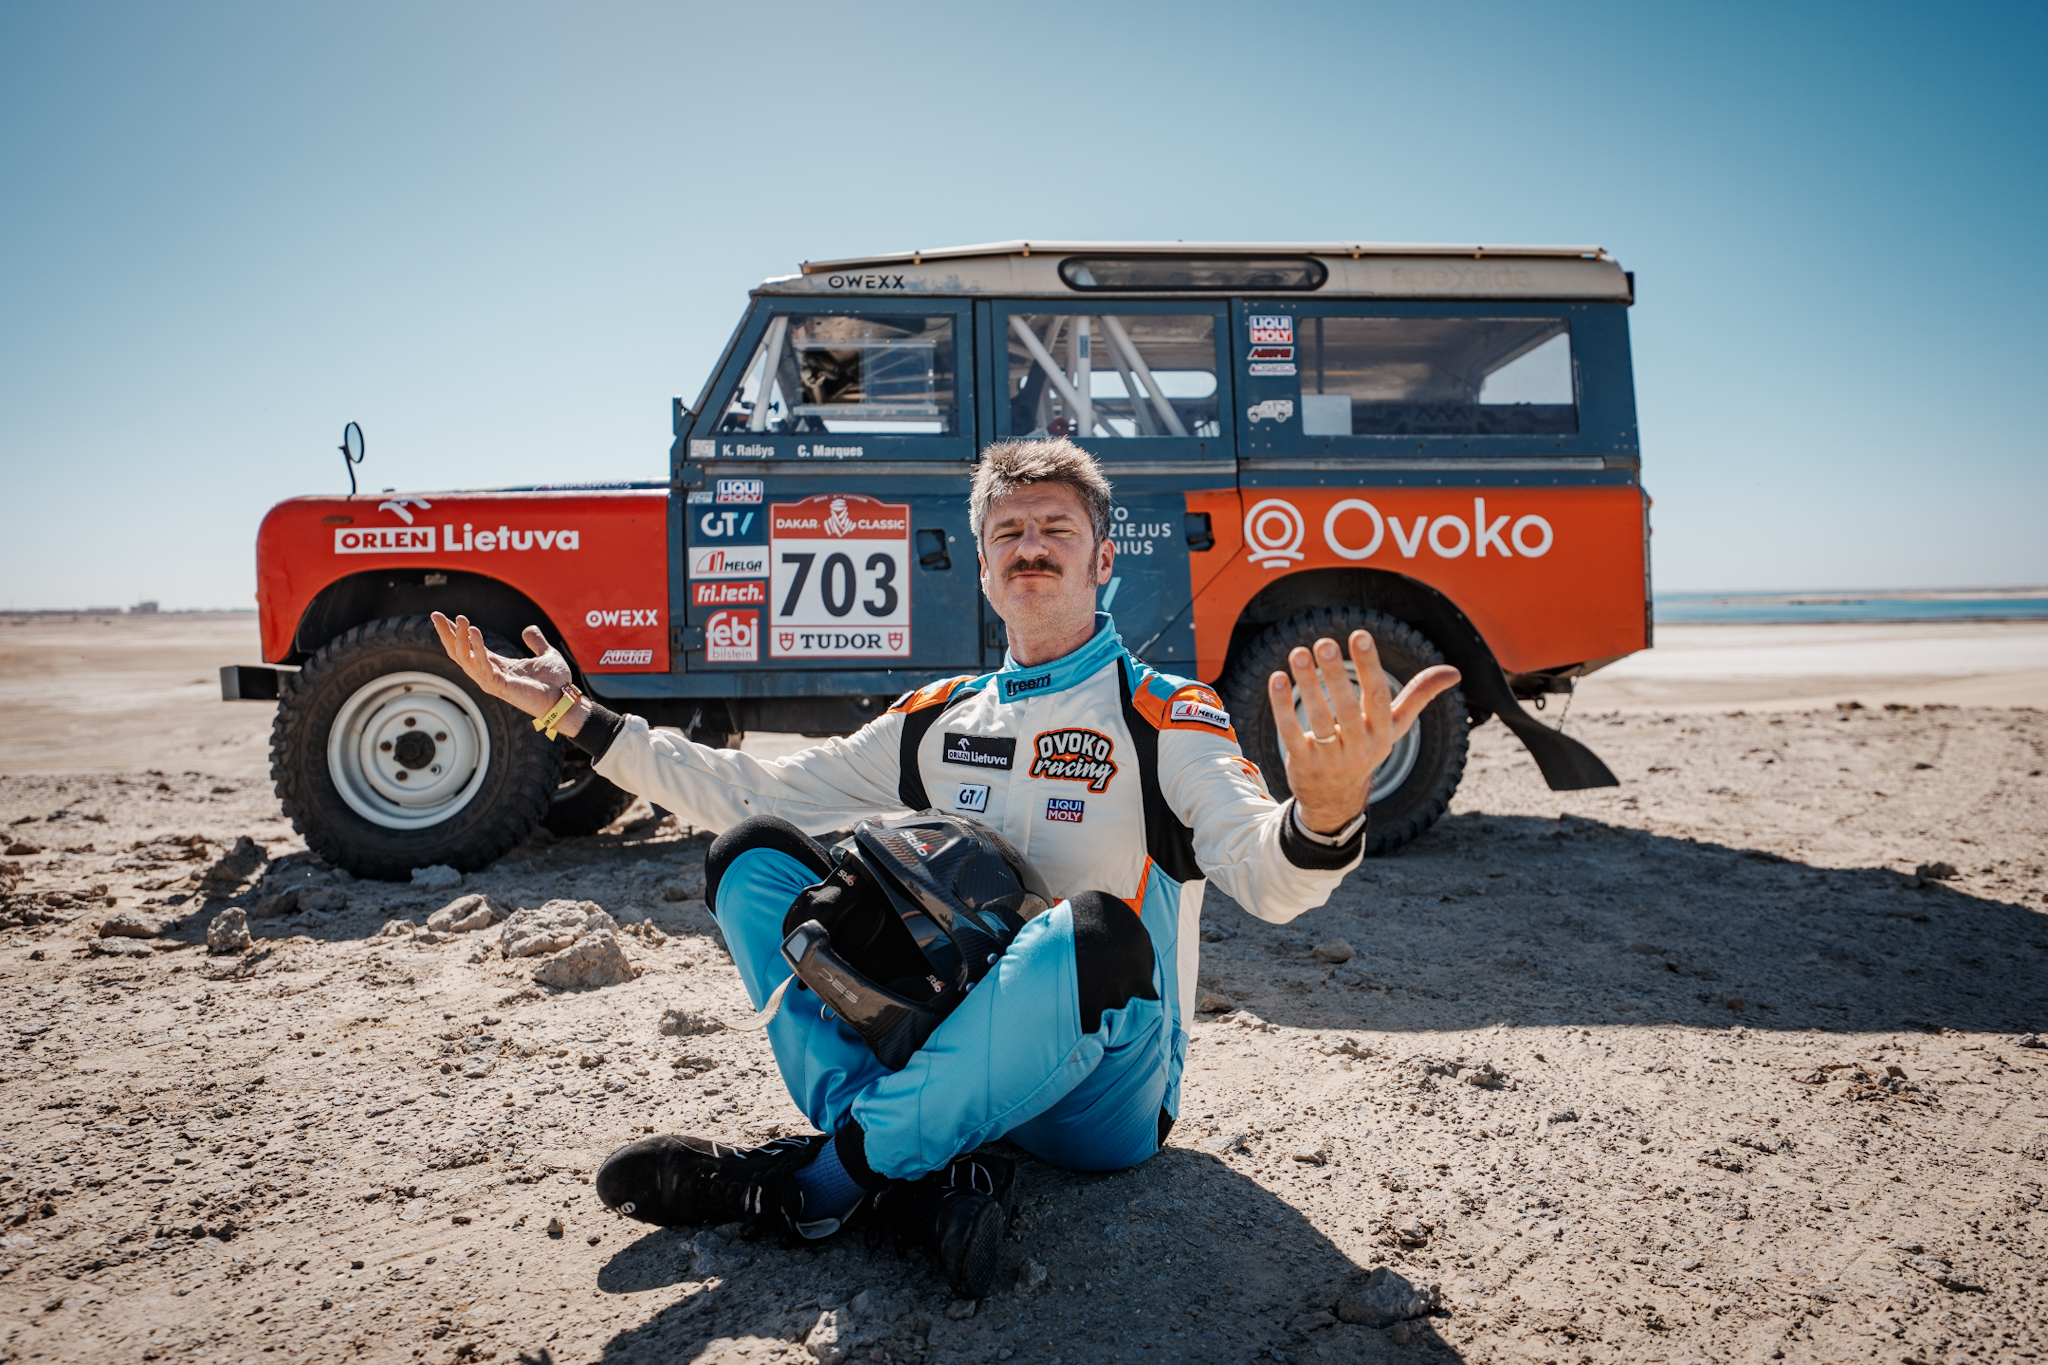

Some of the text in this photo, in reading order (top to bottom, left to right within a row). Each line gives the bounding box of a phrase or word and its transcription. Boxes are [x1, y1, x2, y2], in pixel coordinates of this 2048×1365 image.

[828, 274, 905, 290] OWEXX
[1252, 317, 1290, 330] LIQUI
[1253, 329, 1291, 342] MOLY
[722, 444, 735, 457] K.
[797, 445, 811, 458] C.
[812, 445, 864, 459] Marques
[720, 481, 760, 494] LIQUI
[719, 493, 761, 503] MOLY
[775, 518, 906, 531] DAKAR CLASSIC
[1108, 522, 1172, 538] ZIEJUS
[1323, 497, 1554, 560] Ovoko
[340, 523, 580, 552] ORLEN Lietuva
[1114, 540, 1154, 556] NIUS
[724, 559, 763, 571] MELGA
[779, 552, 899, 618] 703
[585, 609, 659, 628] OWEXX
[705, 611, 758, 648] febi
[800, 633, 883, 649] TUDOR
[712, 647, 752, 659] bilstein
[1004, 673, 1052, 697] freem
[1038, 732, 1111, 762] OVOKO
[948, 750, 1008, 766] ORLEN Lietuva
[1033, 757, 1114, 790] racing
[1048, 799, 1083, 812] LIQUI
[1047, 809, 1082, 822] MOLY
